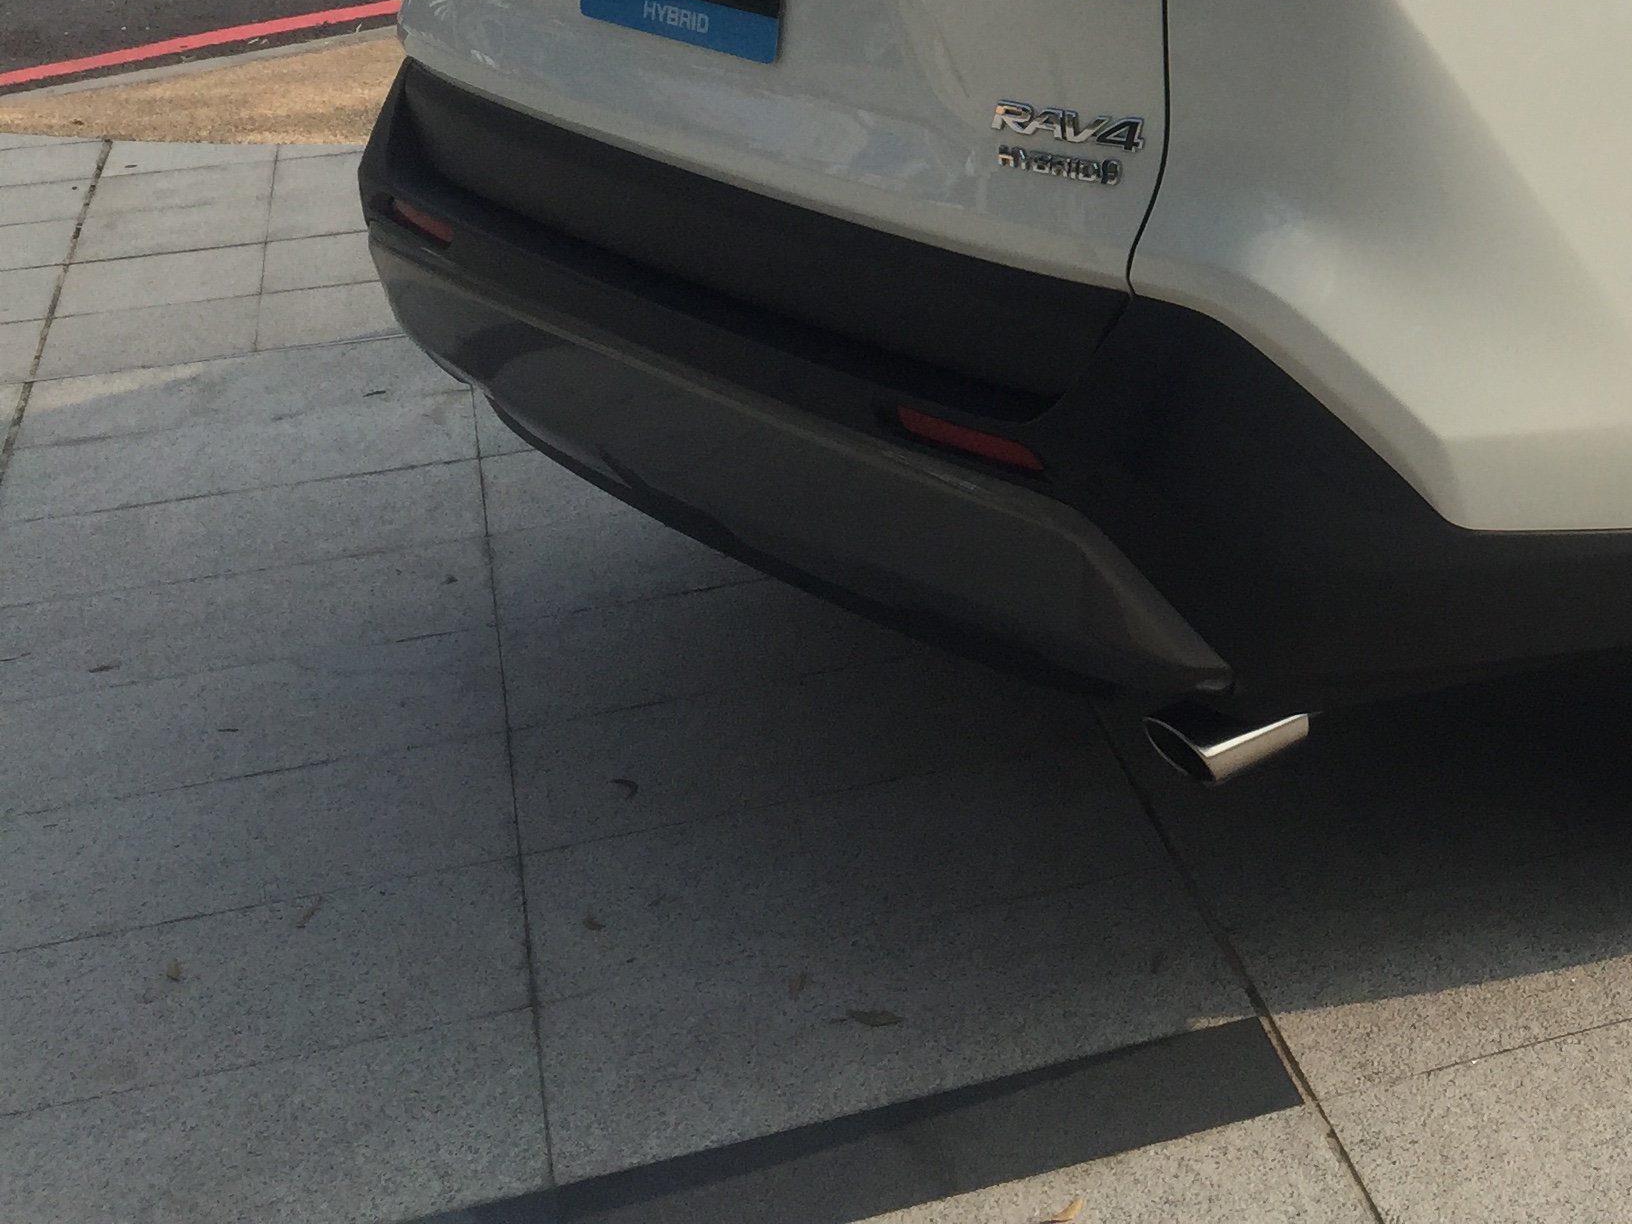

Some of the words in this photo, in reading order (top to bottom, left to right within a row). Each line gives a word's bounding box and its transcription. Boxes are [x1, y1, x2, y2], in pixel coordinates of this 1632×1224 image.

[642, 0, 710, 34] HYBRID
[991, 99, 1146, 154] RAV4
[998, 144, 1103, 183] HYBRID
